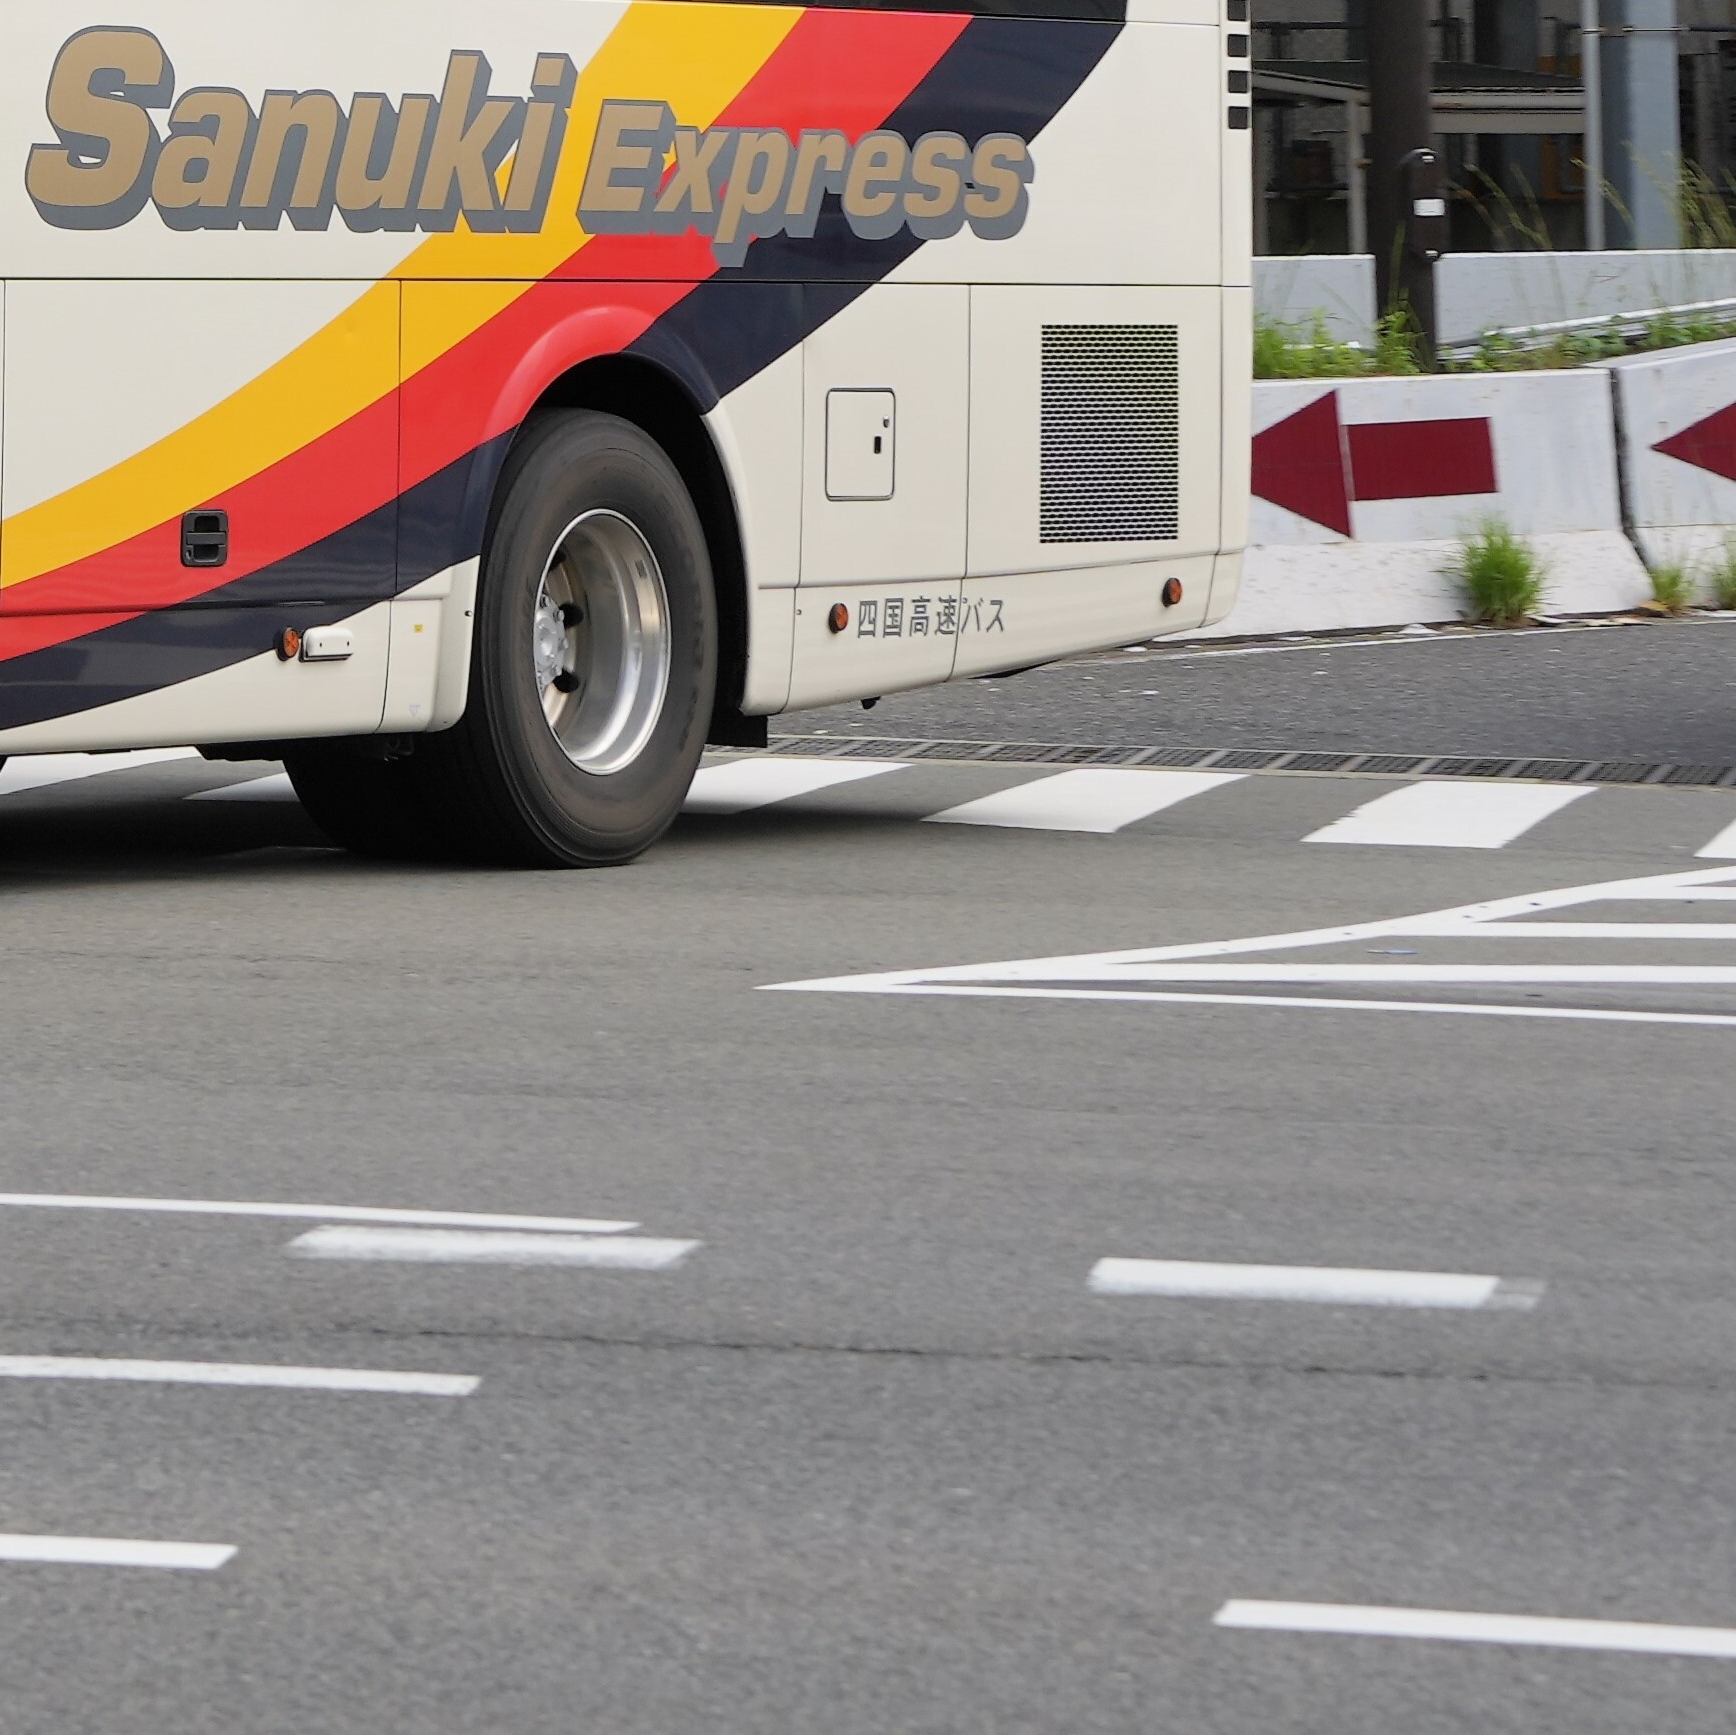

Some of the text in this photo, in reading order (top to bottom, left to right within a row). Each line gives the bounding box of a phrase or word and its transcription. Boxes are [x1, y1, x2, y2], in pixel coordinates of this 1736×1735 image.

[24, 26, 1035, 268] Sanuki Express
[857, 595, 1004, 639] 四国高速バス
